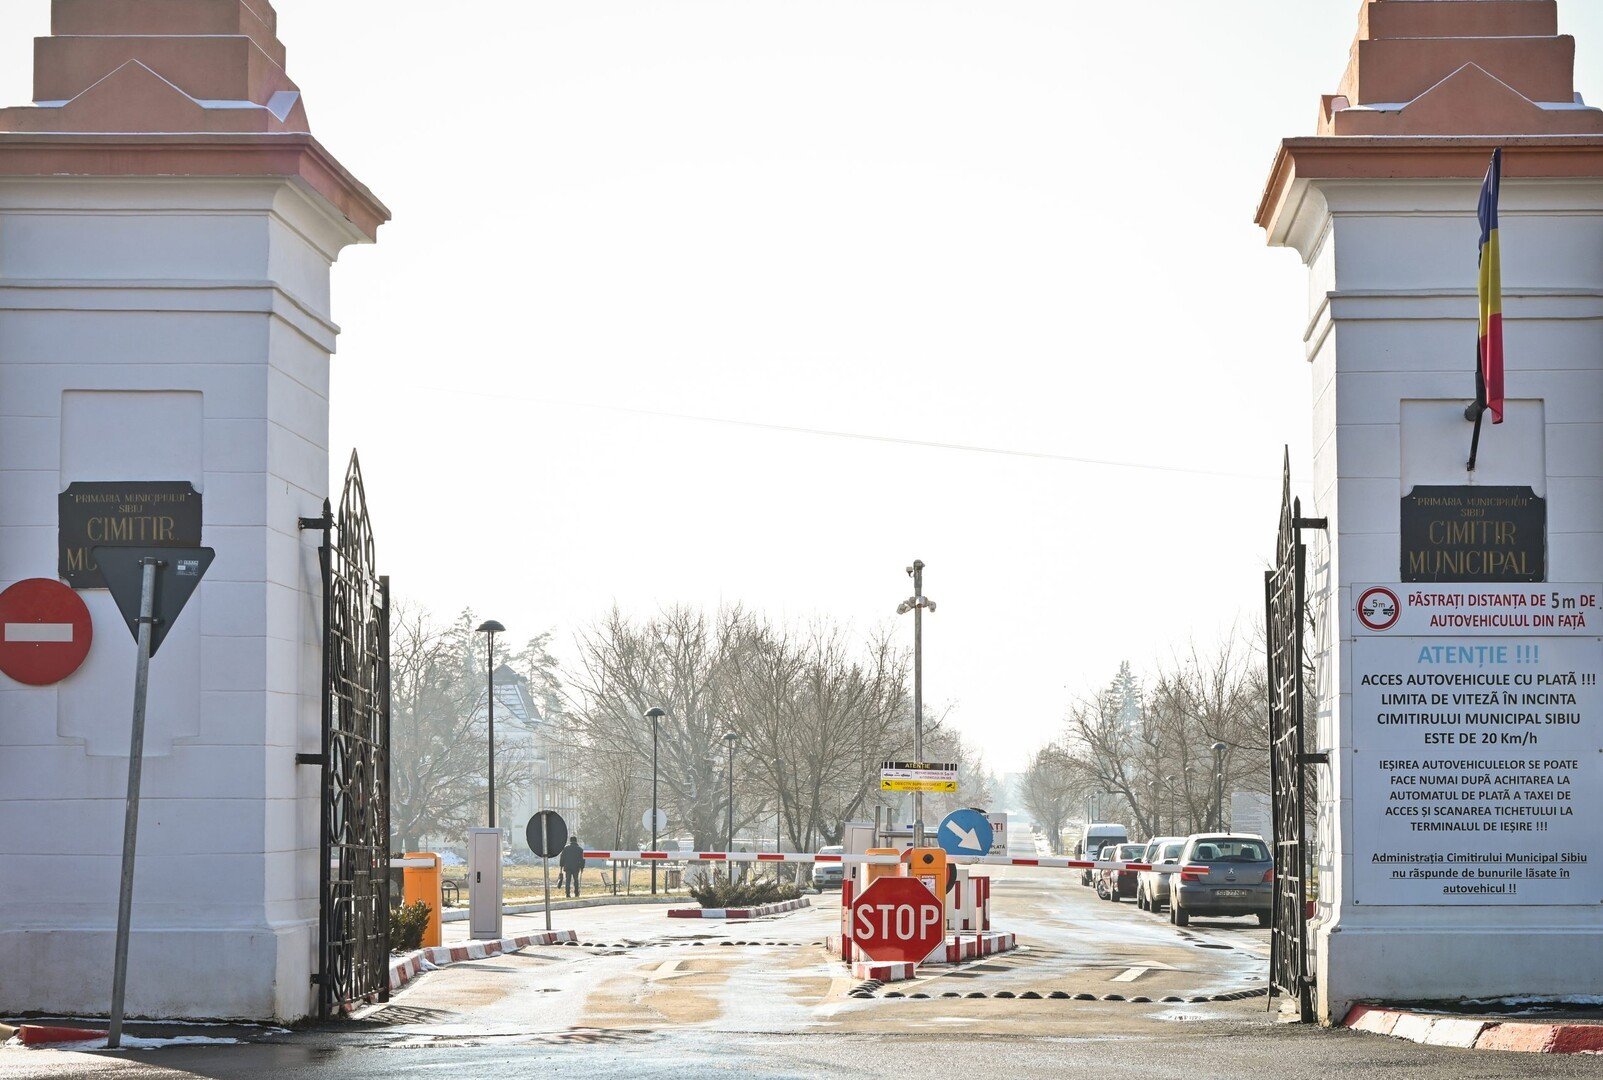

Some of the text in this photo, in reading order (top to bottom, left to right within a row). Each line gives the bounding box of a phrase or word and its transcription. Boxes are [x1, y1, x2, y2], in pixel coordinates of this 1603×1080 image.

[87, 516, 175, 541] CIMITIR
[1429, 520, 1516, 545] CIMITIR
[1409, 550, 1535, 575] MUNICIPAL
[1531, 595, 1547, 606] DE
[1581, 595, 1596, 606] DE
[1533, 615, 1554, 626] DIN
[1517, 645, 1539, 663] !!!
[1361, 674, 1403, 685] ACCES
[1407, 674, 1510, 685] AUTOVEHICULE
[1514, 675, 1533, 685] CU
[1581, 674, 1596, 686] !!!
[1382, 694, 1428, 704] LIMITA
[1432, 694, 1449, 704] DE
[1503, 691, 1518, 704] ÎN
[1523, 694, 1577, 704] INCINTA
[1378, 713, 1581, 724] CIMITIRULUI MUNICIPAL SIBIU
[1425, 732, 1538, 746] ESTE DE 20 Km/h
[1422, 760, 1526, 769] AUTOVEHICULELOR
[1529, 760, 1541, 769] SE
[1544, 760, 1578, 769] POATE
[1391, 776, 1417, 784] FACE
[1420, 776, 1458, 784] NUMAI
[1494, 776, 1555, 784] ACHITAREA
[1558, 776, 1571, 784] LA
[1390, 791, 1459, 800] AUTOMATUL
[1462, 791, 1476, 800] DE
[1514, 791, 1522, 800] A
[1524, 791, 1554, 800] TAXEI
[1557, 791, 1571, 800] DE
[1385, 807, 1419, 815] ACCES
[1434, 807, 1492, 815] SCANAREA
[1495, 807, 1557, 815] TICHETULUI
[1561, 807, 1574, 815] LA
[1411, 822, 1481, 831] TERMINALUL
[1484, 822, 1498, 831] DE
[1537, 822, 1548, 831] !!!
[1447, 853, 1503, 864] Cimitirului
[1505, 853, 1558, 865] Municipal
[1561, 853, 1587, 864] Sibiu
[1392, 869, 1406, 878] nu
[1462, 868, 1475, 878] de
[1478, 868, 1523, 878] bunurile
[1559, 868, 1570, 878] în
[1443, 883, 1517, 894] autovehicul !!
[856, 904, 939, 940] STOP
